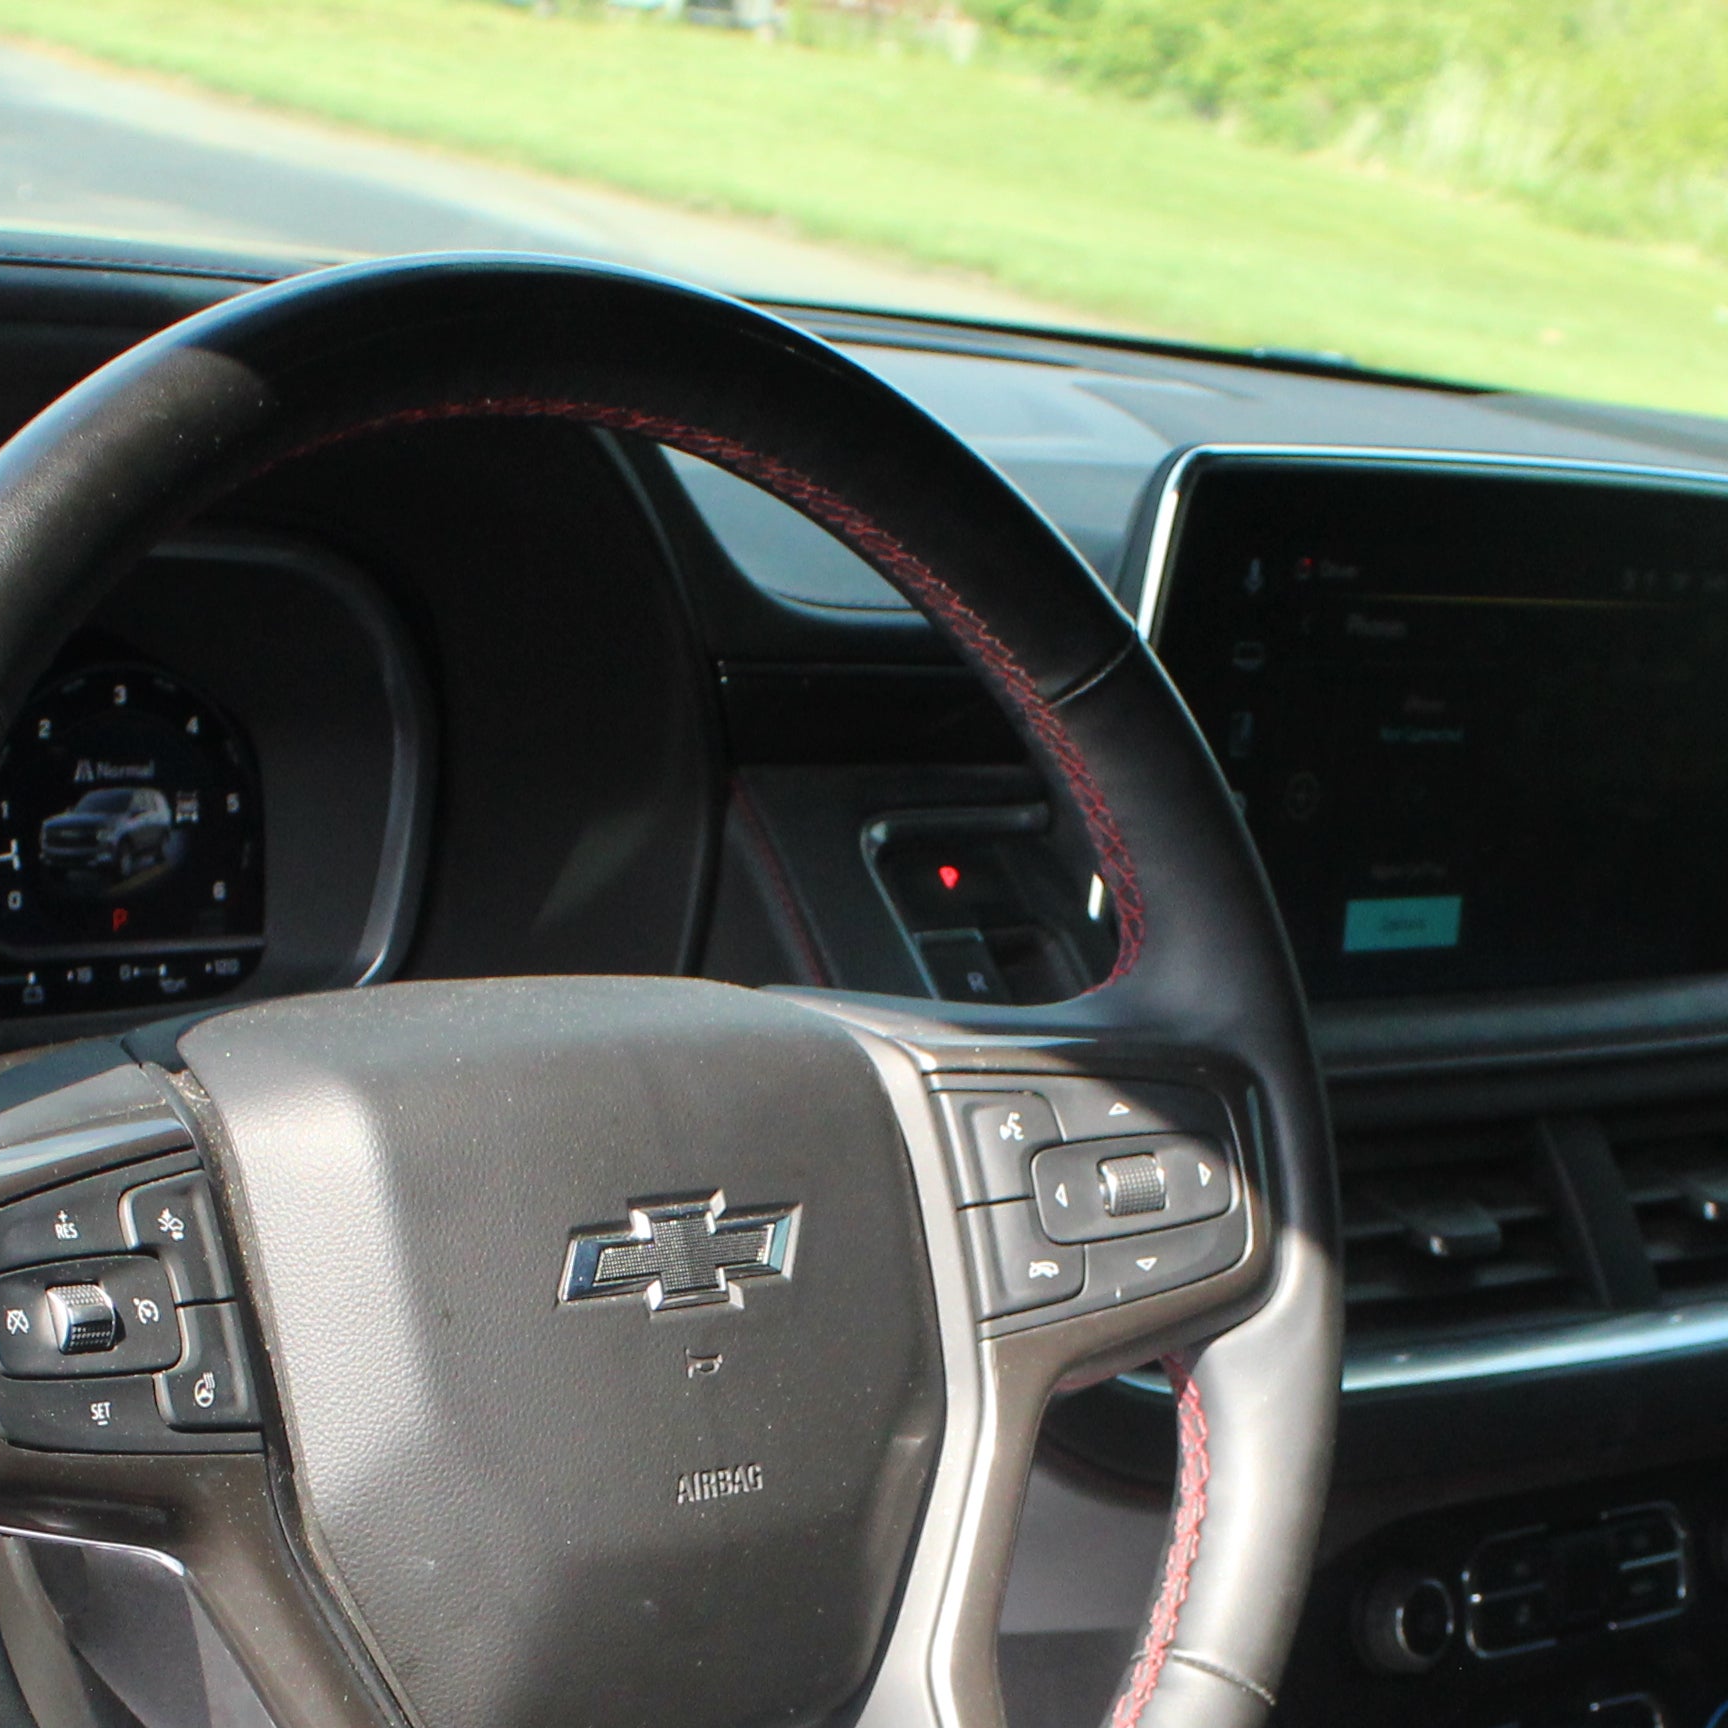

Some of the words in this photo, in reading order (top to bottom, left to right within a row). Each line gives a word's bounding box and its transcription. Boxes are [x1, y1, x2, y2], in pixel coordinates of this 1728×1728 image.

[113, 684, 127, 704] 3
[38, 719, 51, 738] 2
[186, 716, 199, 734] 4
[7, 890, 21, 910] 0
[55, 1223, 78, 1239] RES
[91, 1402, 110, 1419] SET
[677, 1463, 764, 1504] AIRBAG
